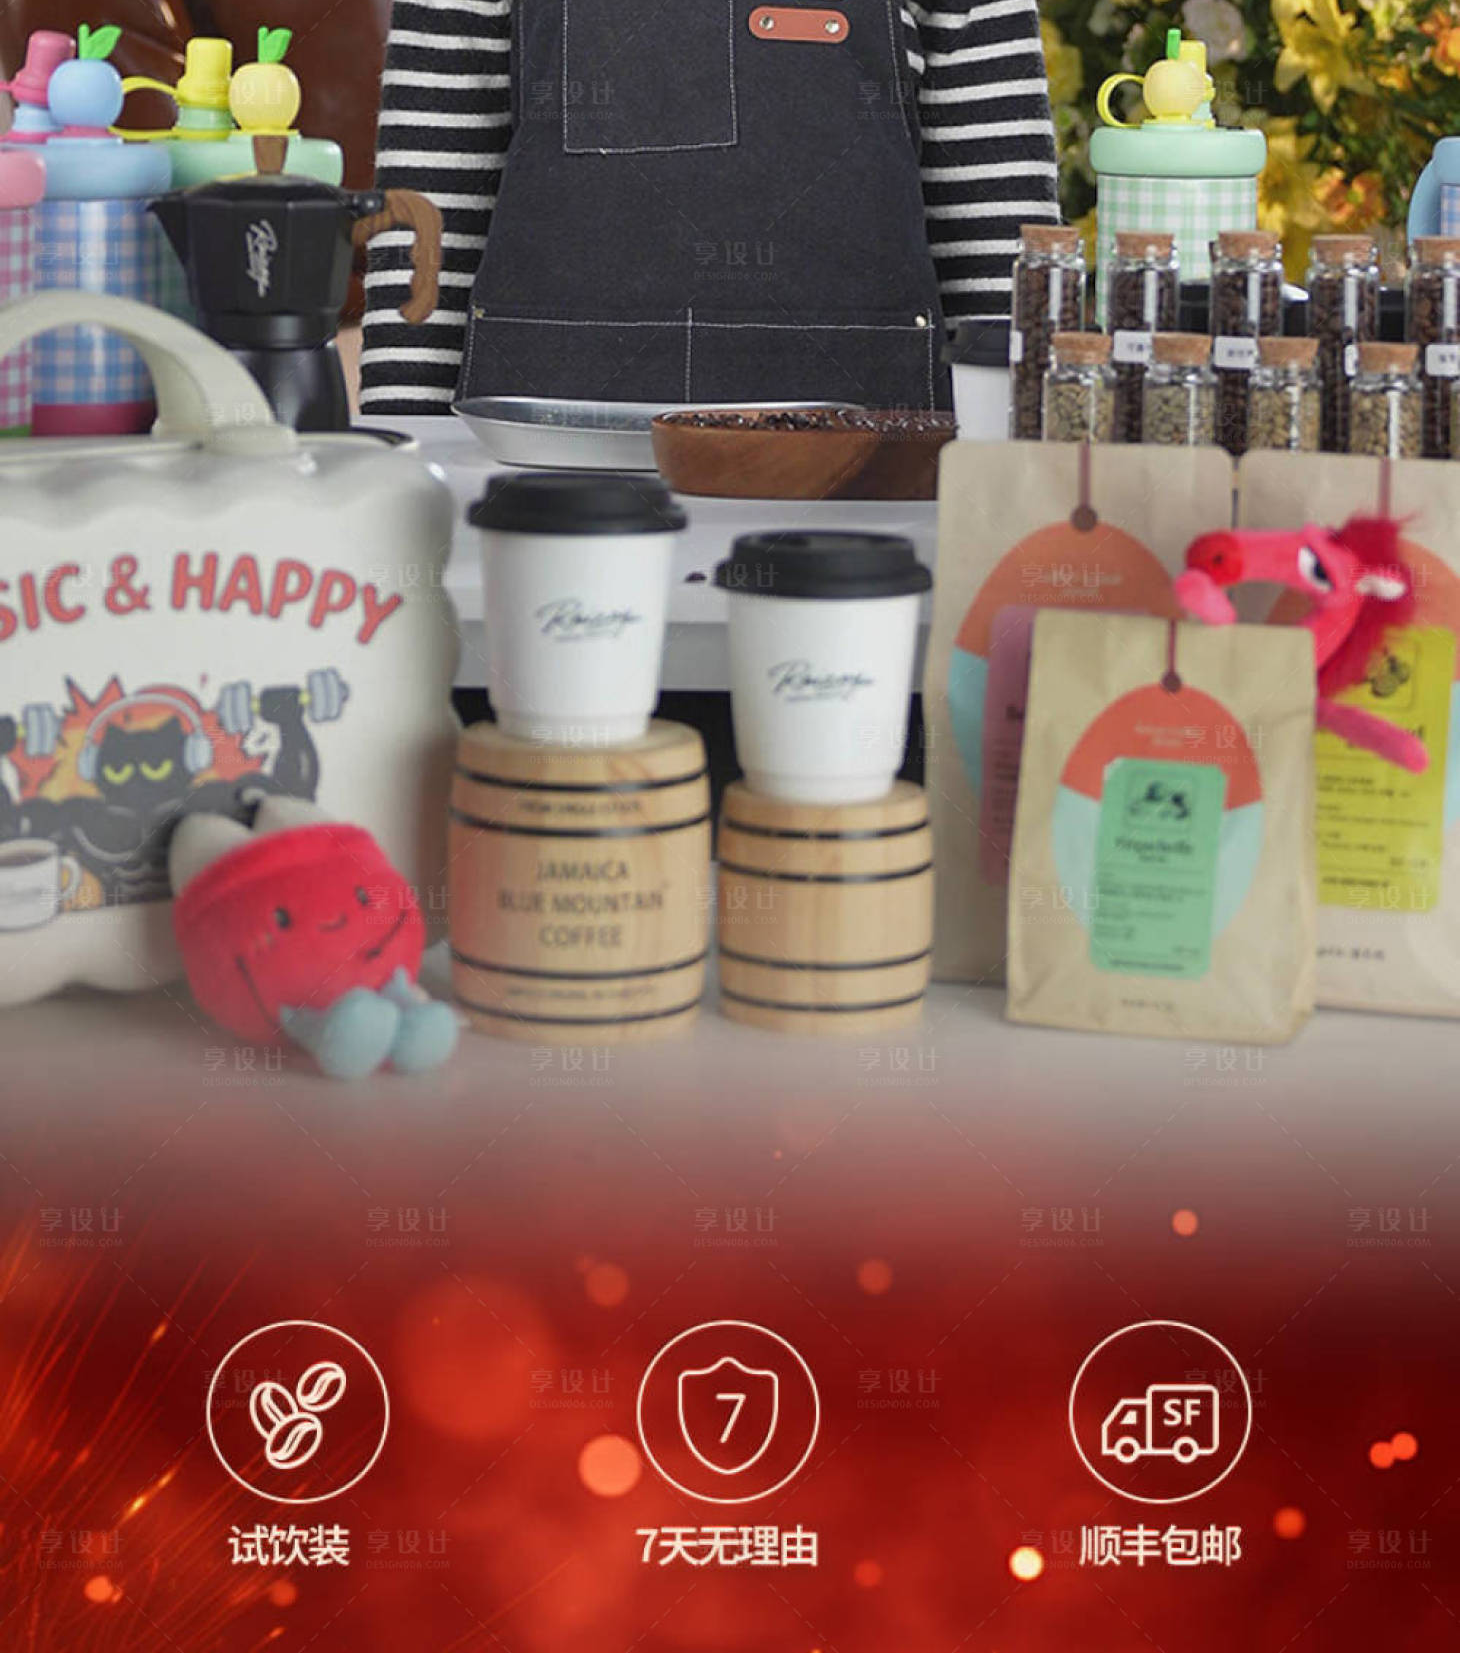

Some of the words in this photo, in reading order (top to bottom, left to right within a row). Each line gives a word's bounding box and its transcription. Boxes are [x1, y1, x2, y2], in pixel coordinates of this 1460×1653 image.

[104, 554, 152, 616] &
[171, 551, 403, 645] HAPPY
[536, 859, 629, 881] JAMAICA
[551, 889, 664, 915] MOUNTAIN
[538, 924, 622, 947] COFFEE
